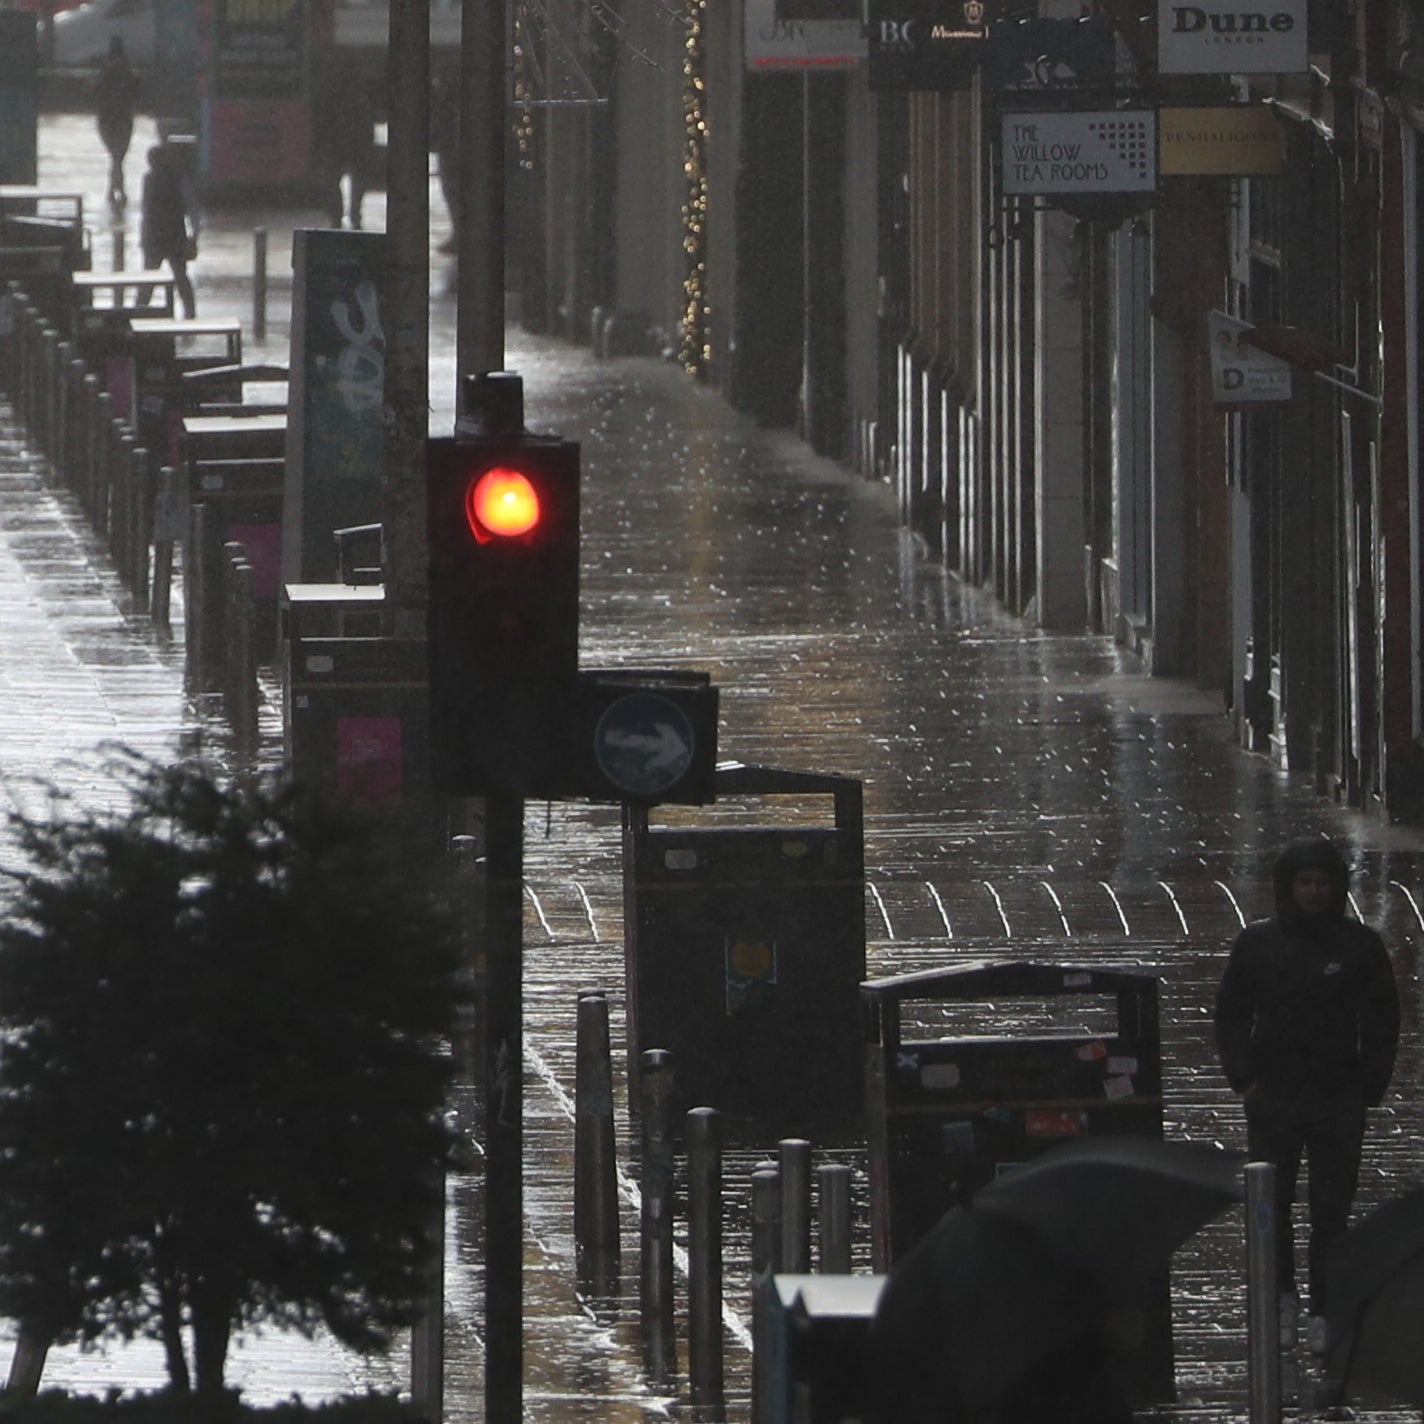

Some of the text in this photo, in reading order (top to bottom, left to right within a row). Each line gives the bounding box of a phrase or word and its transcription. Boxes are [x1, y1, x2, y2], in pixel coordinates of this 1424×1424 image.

[1172, 6, 1295, 33] Dune
[1204, 36, 1264, 44] LONDON
[1012, 124, 1038, 142] THE
[1012, 144, 1081, 162] WILLOW
[1012, 163, 1109, 182] TEA ROOMS
